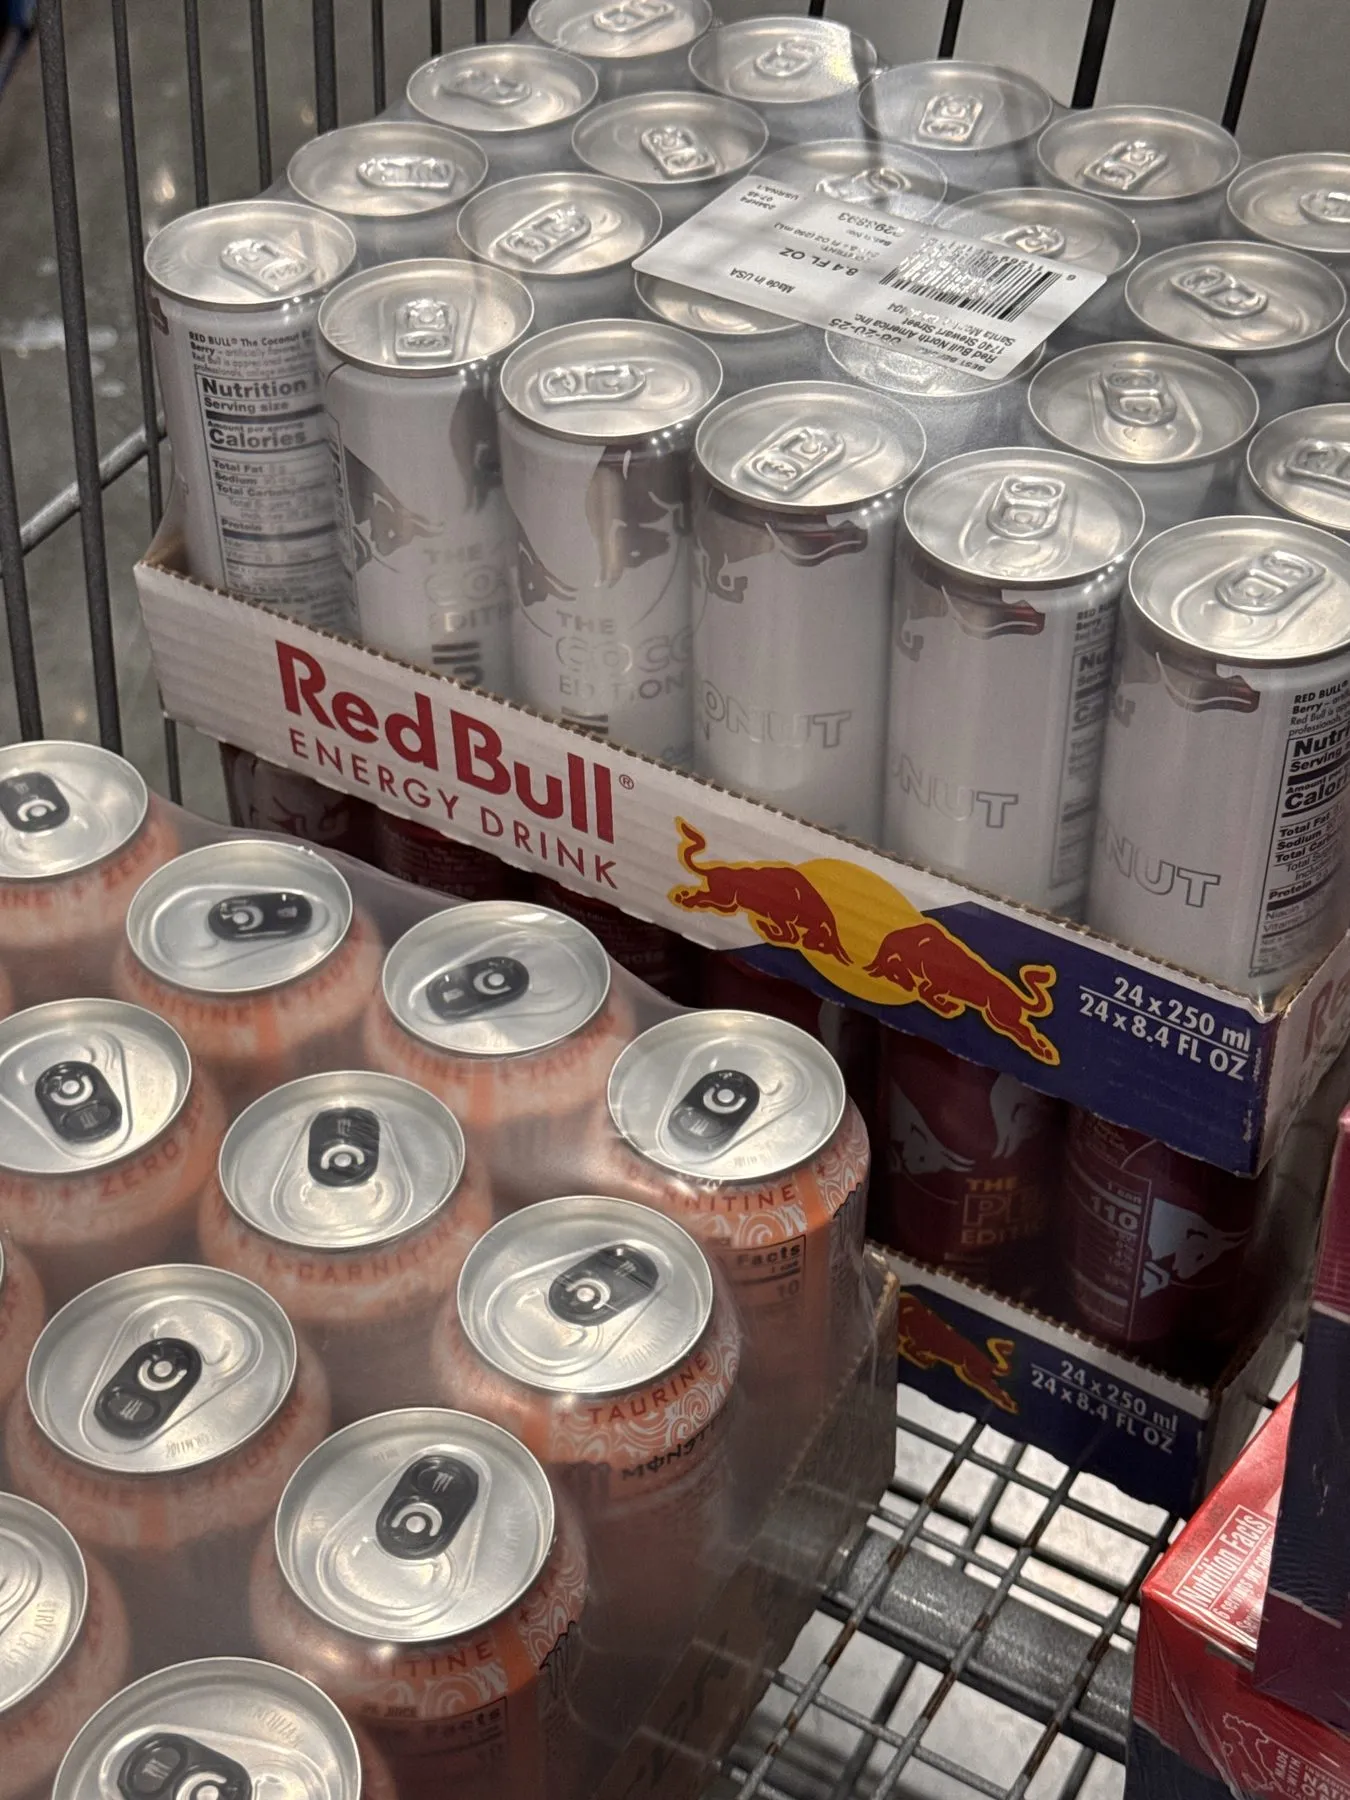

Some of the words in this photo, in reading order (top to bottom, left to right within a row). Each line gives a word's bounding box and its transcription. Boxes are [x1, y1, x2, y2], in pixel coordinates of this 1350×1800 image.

[778, 247, 806, 260] OZ
[812, 256, 831, 268] FL
[832, 263, 858, 276] 8.4
[729, 267, 752, 281] USA
[754, 274, 767, 285] in
[766, 278, 796, 294] Made
[854, 313, 874, 325] Inc.
[902, 317, 935, 332] Street
[873, 320, 919, 339] America
[935, 328, 976, 346] Stewart
[188, 331, 206, 343] RED
[241, 338, 258, 348] The
[261, 333, 300, 346] Coconut
[918, 335, 946, 350] North
[984, 331, 1017, 347] Santa
[190, 342, 215, 356] Berry
[948, 344, 970, 358] Bull
[976, 341, 1006, 355] 1740
[960, 360, 986, 372] BEST
[973, 352, 998, 364] Red
[202, 377, 306, 398] Nutrition
[204, 397, 256, 414] Serving
[260, 400, 290, 411] size
[207, 420, 244, 432] Amount
[208, 428, 306, 449] Calories
[212, 458, 240, 472] Total
[244, 462, 264, 474] Fat
[214, 471, 258, 486] Sodium
[216, 484, 244, 496] Total
[220, 517, 262, 532] Protein
[276, 640, 440, 772] Red
[1294, 692, 1316, 704] RED
[1292, 702, 1322, 714] Berry
[1290, 746, 1342, 772] Serving
[1286, 776, 1327, 794] Amount
[289, 727, 460, 821] ENERGY
[480, 805, 619, 890] DRINK
[1280, 822, 1310, 838] Total
[1314, 812, 1330, 828] Fat
[1276, 830, 1322, 851] Sodium
[1275, 848, 1306, 863] Total
[1286, 858, 1310, 872] Total
[1268, 880, 1312, 900] Protein
[1114, 976, 1144, 1007] 24
[1148, 996, 1162, 1016] x
[1167, 998, 1215, 1036] 250
[1221, 1026, 1250, 1052] ml
[1079, 992, 1109, 1023] 24
[1112, 1012, 1127, 1032] x
[1130, 1015, 1170, 1049] 8.4
[1176, 1034, 1202, 1064] FL
[1209, 1048, 1248, 1082] OZ
[736, 1244, 802, 1266] Facts
[776, 1279, 800, 1300] 10
[587, 1353, 709, 1426] TAURINE
[1060, 1360, 1086, 1387] 24
[1090, 1380, 1102, 1396] x
[1106, 1384, 1146, 1416] 250
[1152, 1411, 1178, 1432] ml
[1031, 1370, 1057, 1396] 24
[1060, 1388, 1073, 1404] x
[1076, 1392, 1108, 1421] 8.4
[1116, 1412, 1136, 1436] FL
[1144, 1426, 1173, 1454] OZ
[1178, 1548, 1241, 1608] Nutrition
[1218, 1515, 1267, 1554] Facts
[1243, 1564, 1265, 1586] per
[1220, 1580, 1256, 1615] servings
[1212, 1608, 1231, 1620] 6
[1274, 1748, 1289, 1780] MADE
[1286, 1756, 1302, 1786] WITH
